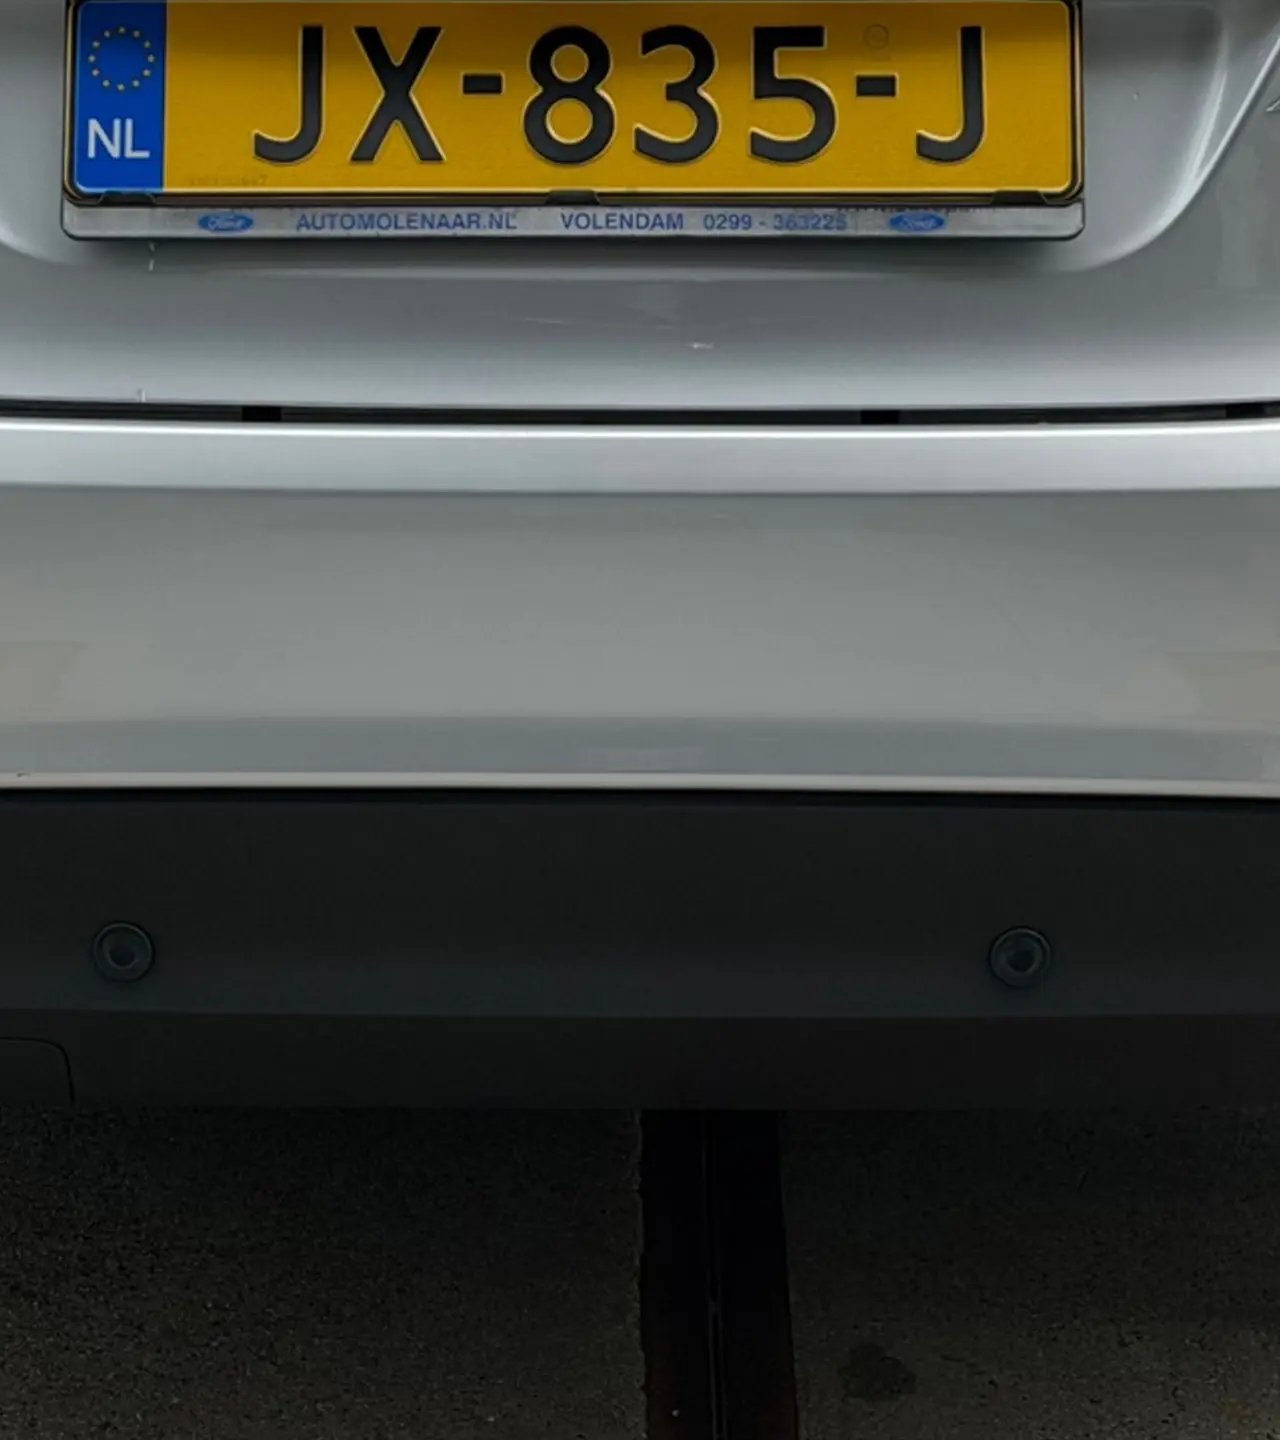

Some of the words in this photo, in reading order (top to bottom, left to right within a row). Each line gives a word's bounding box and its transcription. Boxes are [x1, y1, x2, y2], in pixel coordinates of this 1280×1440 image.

[252, 24, 983, 164] JX-835-J
[87, 117, 151, 159] NL
[296, 212, 518, 232] AUTOMOLENAAR.NL
[561, 212, 684, 231] VOLENDAM
[703, 213, 753, 231] 0299
